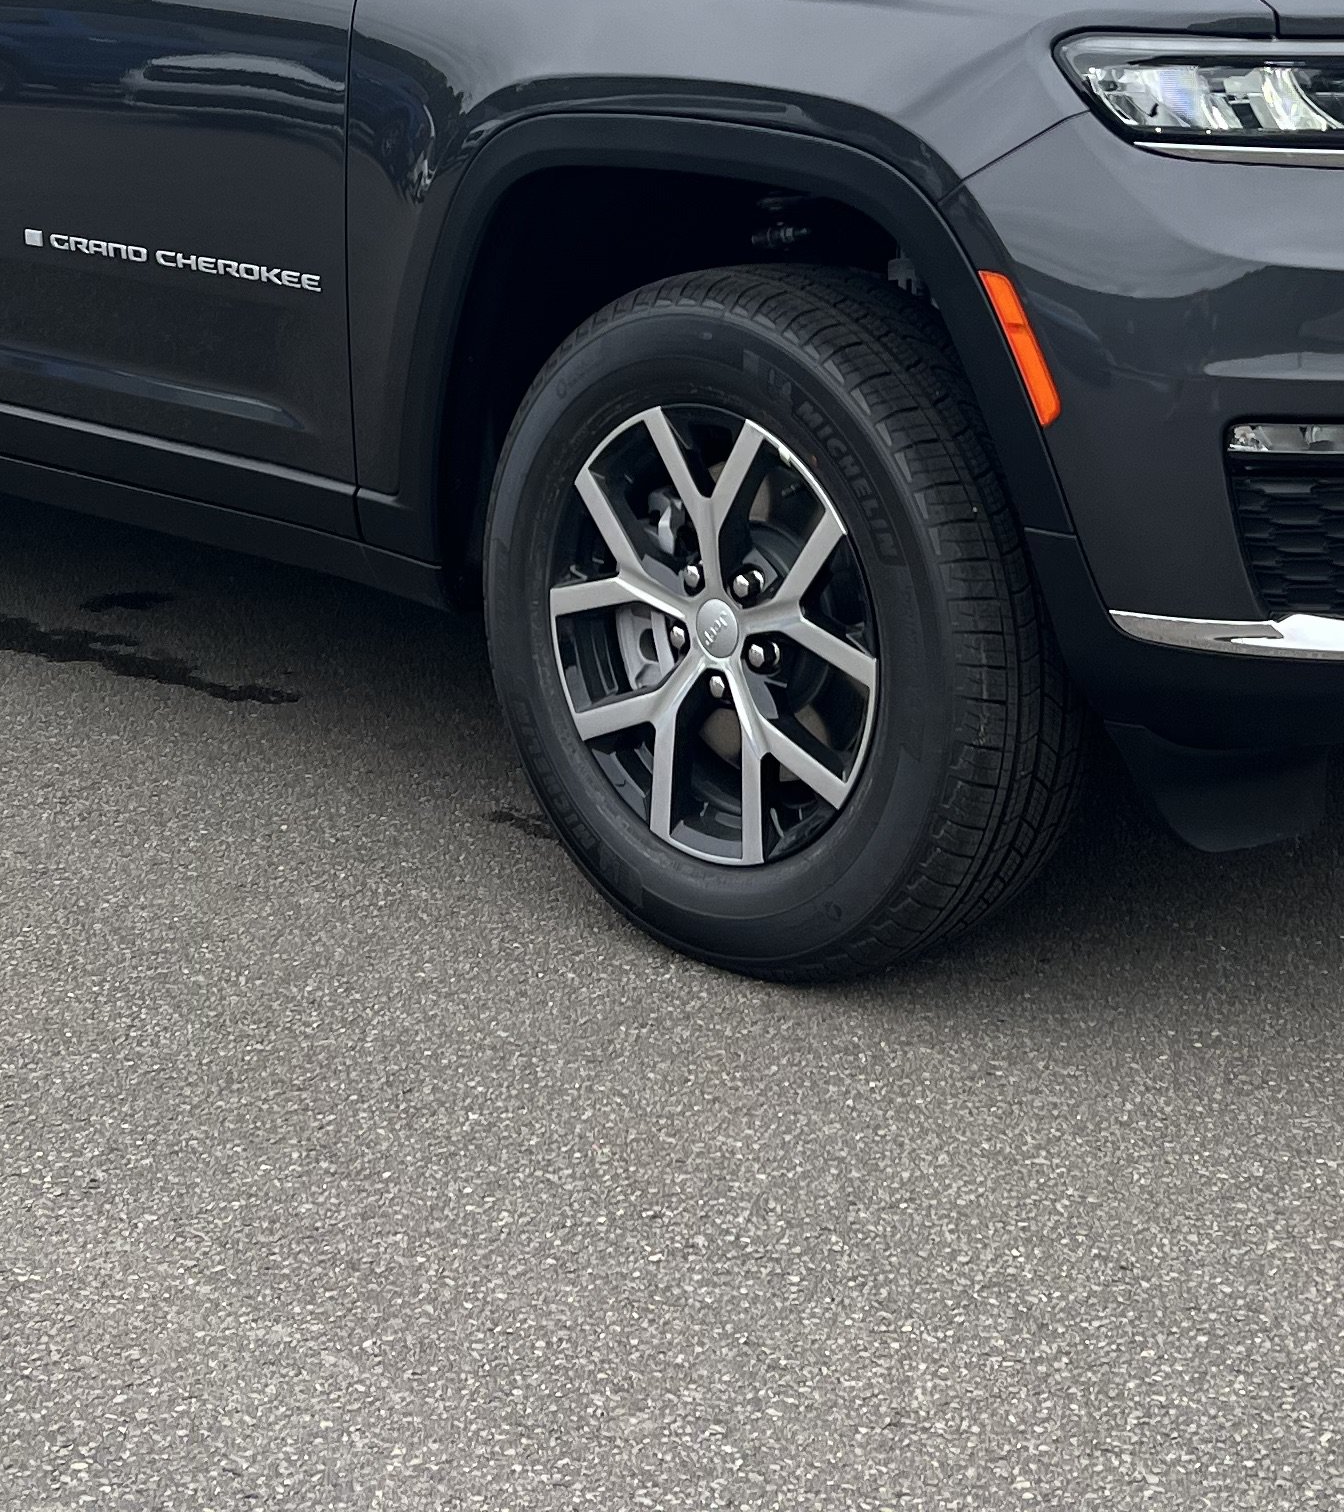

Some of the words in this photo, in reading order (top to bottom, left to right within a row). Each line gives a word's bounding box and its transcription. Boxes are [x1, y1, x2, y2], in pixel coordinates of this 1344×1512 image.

[49, 233, 148, 263] GRAND
[156, 249, 322, 292] CHEROKEE
[795, 400, 898, 558] MICHELIN
